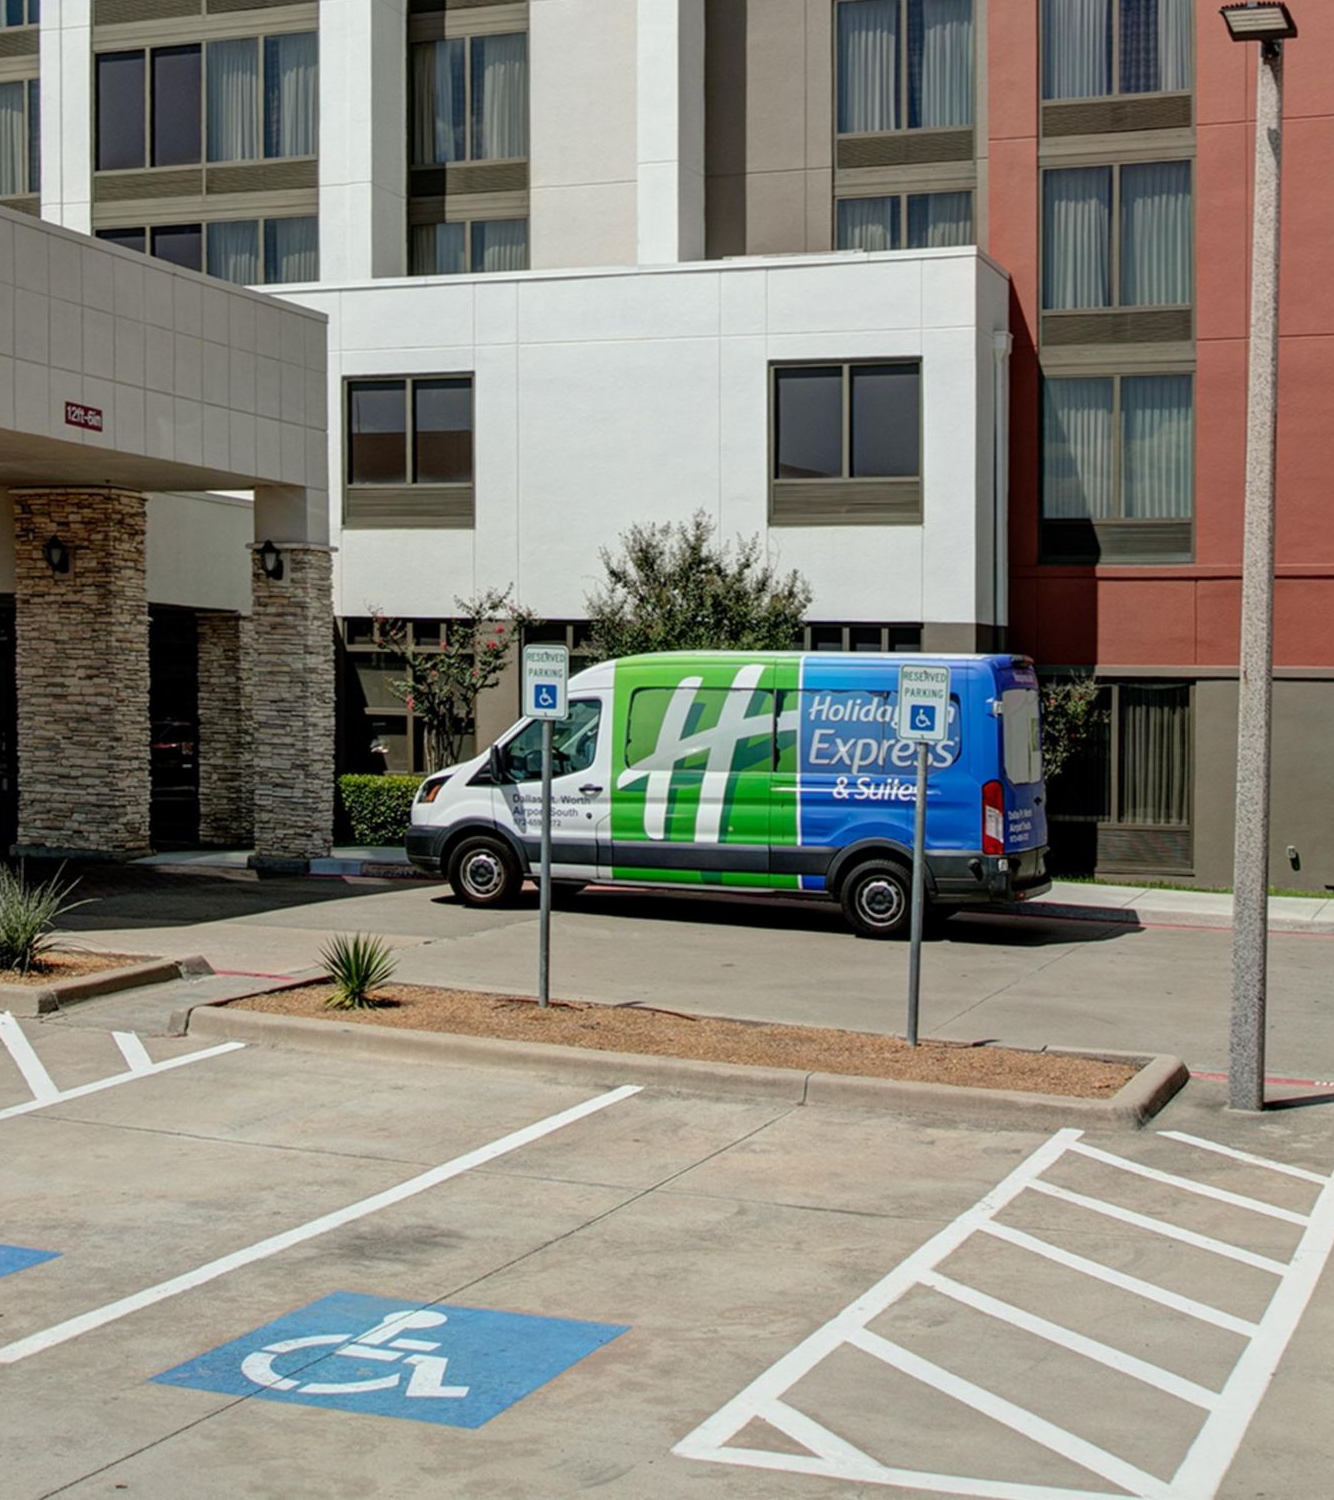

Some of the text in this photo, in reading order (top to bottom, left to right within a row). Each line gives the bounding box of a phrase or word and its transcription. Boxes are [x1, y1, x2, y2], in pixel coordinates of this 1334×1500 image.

[527, 651, 565, 663] RESERVED
[528, 668, 563, 678] PARKING
[904, 670, 946, 683] RESERVED
[905, 687, 944, 699] PARKING
[832, 776, 850, 800] &
[560, 795, 591, 804] Worth
[550, 807, 579, 817] South
